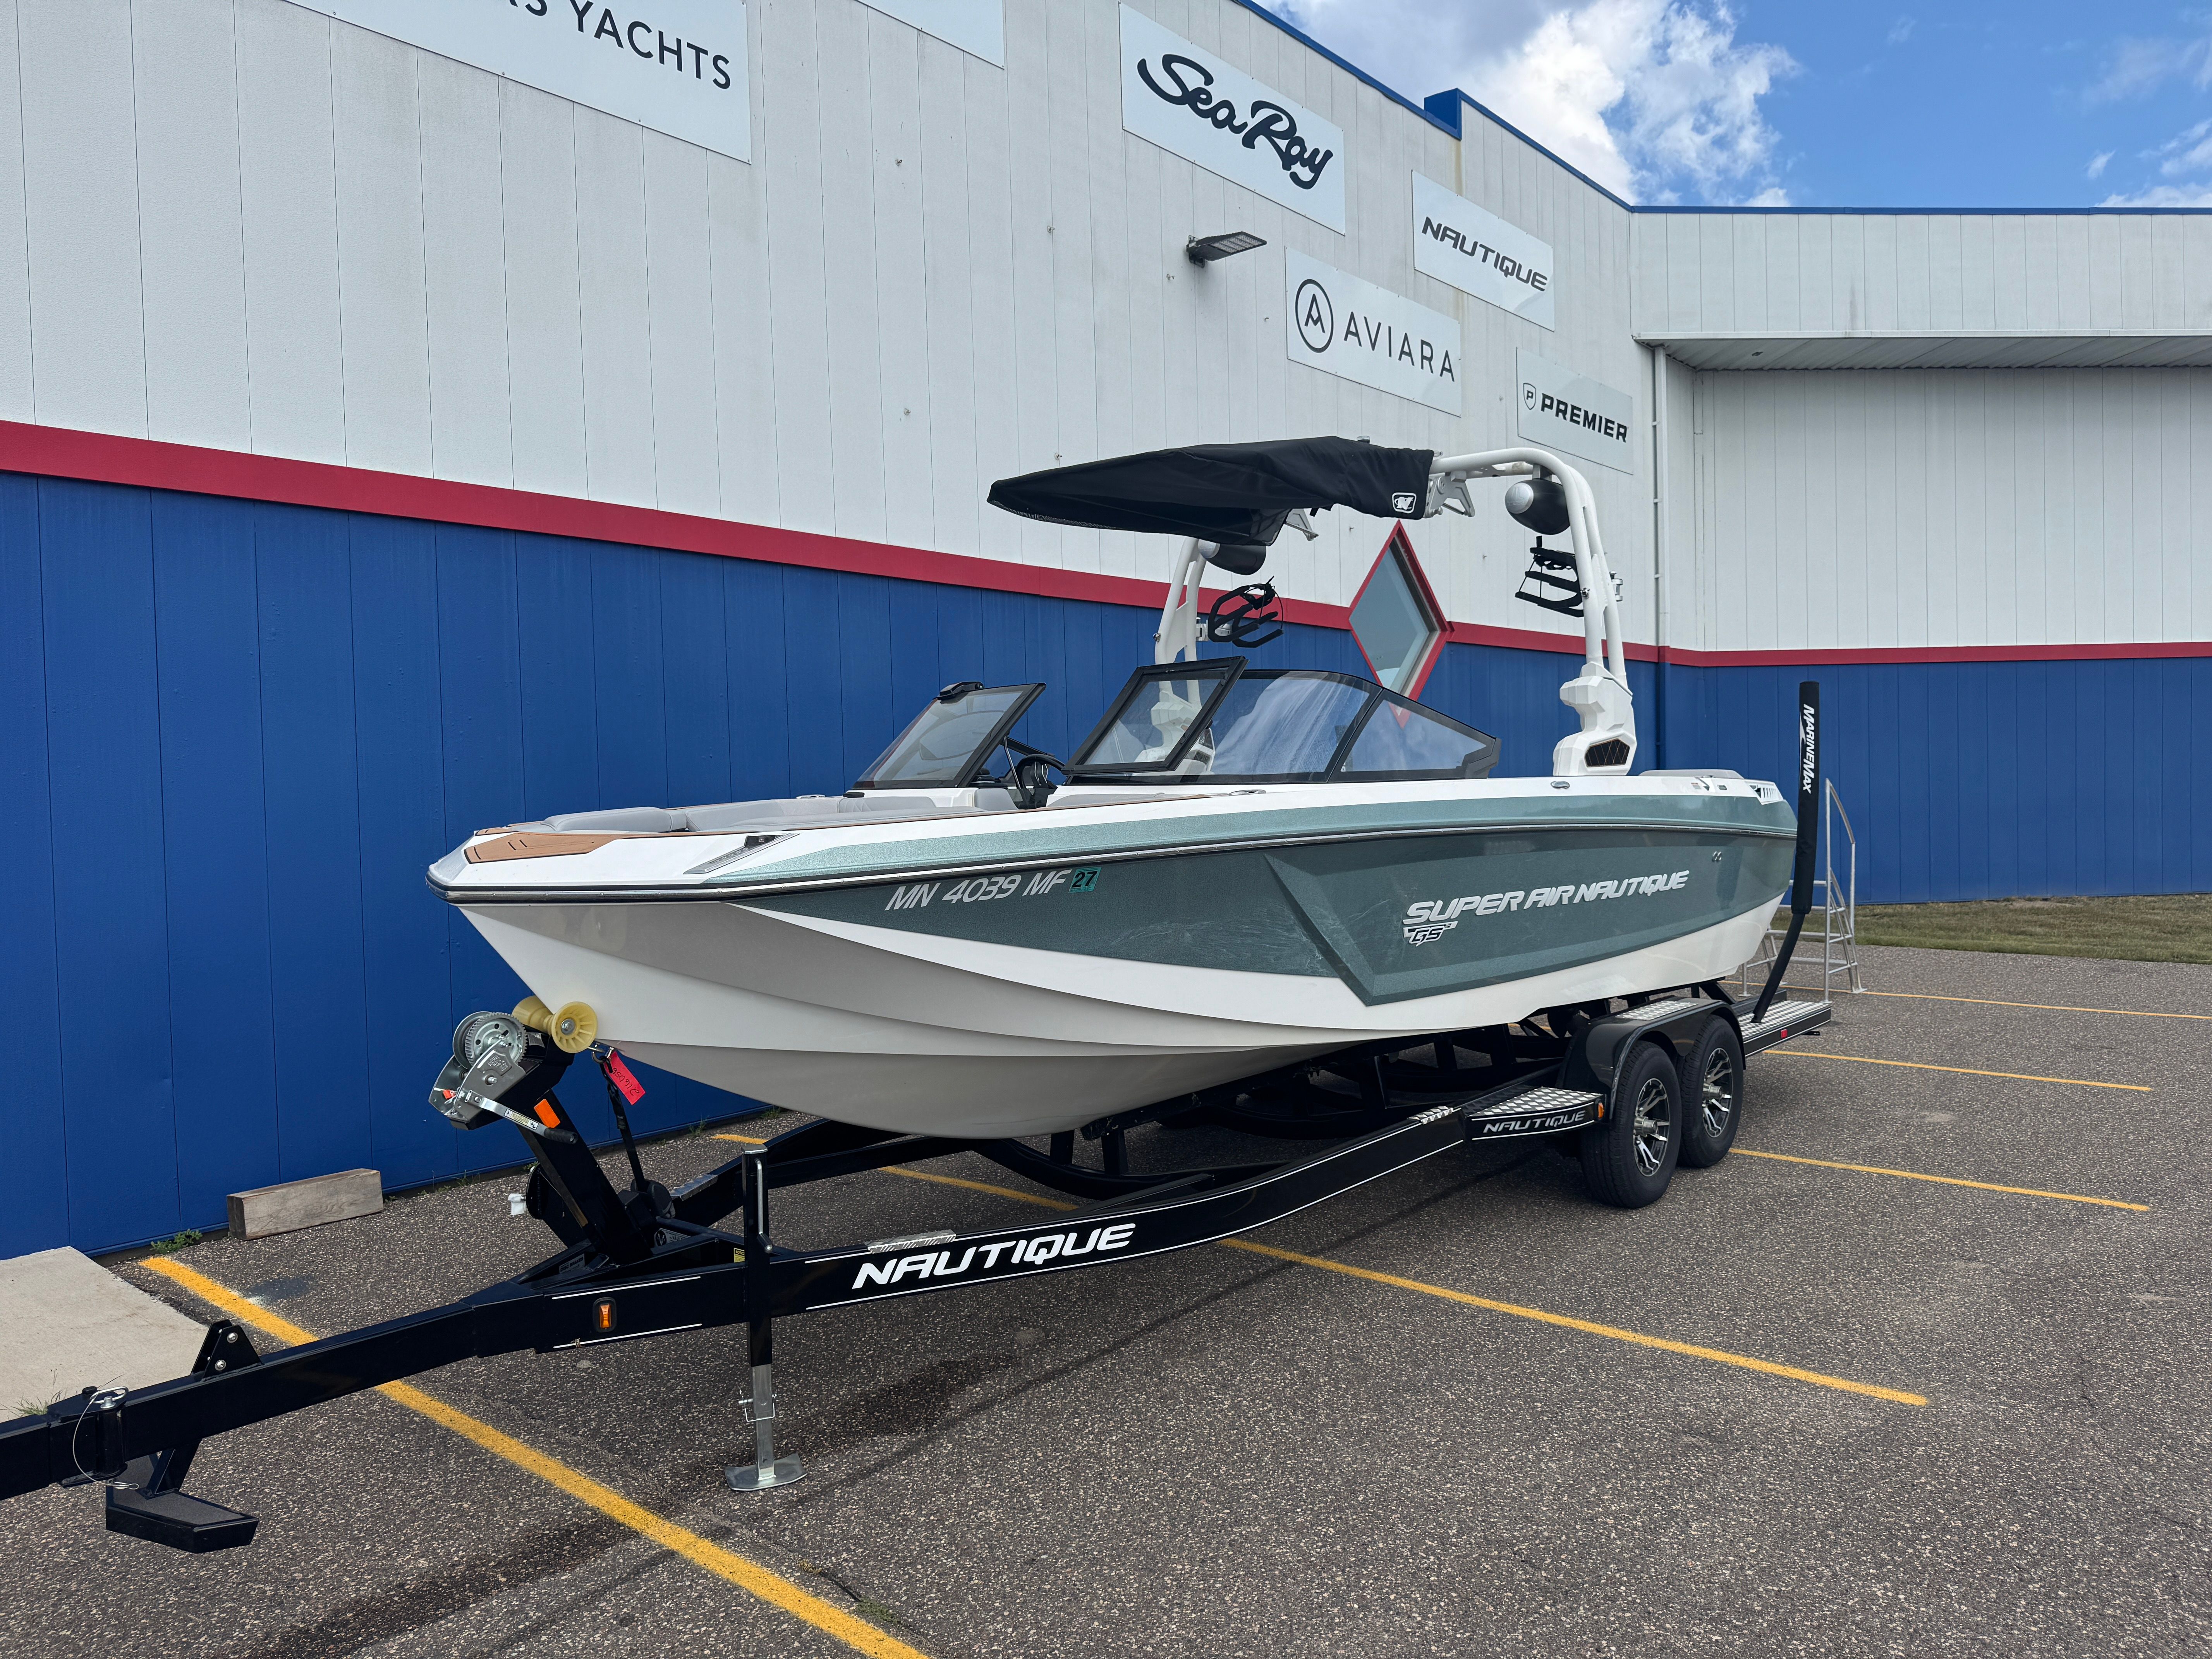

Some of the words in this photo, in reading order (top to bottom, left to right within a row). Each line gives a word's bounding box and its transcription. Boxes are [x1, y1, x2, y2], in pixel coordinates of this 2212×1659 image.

[570, 0, 731, 89] YACHTS
[1137, 54, 1248, 134] Sea
[1242, 100, 1333, 190] Ray
[1422, 216, 1548, 292] NAUTIQUE
[1343, 311, 1455, 382] AVIARA
[1540, 392, 1627, 443] PREMIER
[884, 883, 941, 911] MN
[942, 874, 1022, 904] 4039
[1022, 869, 1072, 896] MF
[1071, 871, 1097, 888] 27
[1403, 890, 1525, 924] SUPER
[1523, 885, 1575, 910] AIR
[1573, 870, 1689, 903] NAUTIQUE
[1483, 1110, 1586, 1133] NAUTIQUE
[852, 1223, 1136, 1289] NAUTIQUE
